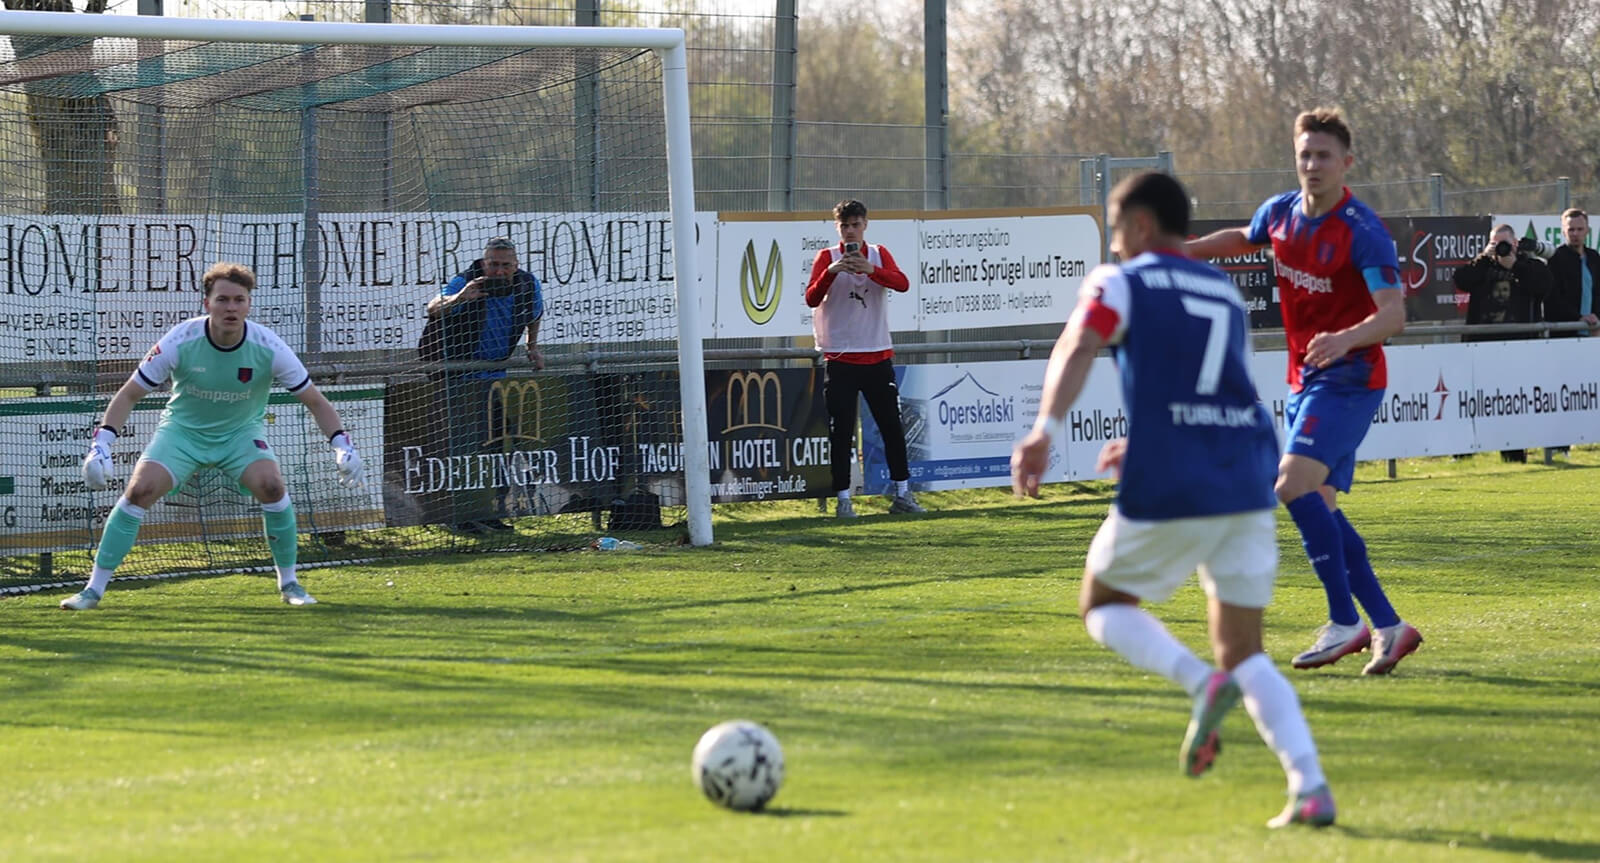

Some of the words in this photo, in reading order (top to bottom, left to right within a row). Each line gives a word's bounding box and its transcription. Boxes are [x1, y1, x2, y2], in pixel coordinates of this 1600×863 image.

[497, 220, 700, 286] HOMEIE
[920, 228, 1010, 252] Versicherungsbüro
[920, 259, 978, 285] Karlheinz
[981, 256, 1025, 286] Sprügel
[1029, 255, 1051, 278] und
[1054, 255, 1086, 278] Team
[921, 296, 953, 315] Telefon
[956, 295, 980, 312] 07938
[982, 294, 1001, 310] 8830
[1008, 291, 1052, 309] Hollenbach
[0, 311, 144, 331] HVERARBETUNG
[556, 321, 601, 339] SINCE
[608, 321, 645, 337] 1989
[25, 337, 78, 356] SINCE
[323, 328, 354, 346] NCE
[363, 327, 404, 345] 1989
[1180, 295, 1230, 396] 7
[938, 395, 1014, 431] Operskalski
[1391, 392, 1429, 423] GmbH
[1458, 385, 1557, 419] Hollerbach-Bau
[1560, 382, 1598, 412] GmbH
[40, 449, 79, 469] Umbau
[402, 446, 560, 495] EDELFINGER
[568, 436, 620, 483] HOF
[733, 438, 781, 469] HOTEL
[709, 474, 807, 499] ww.edelfinger-hof.de
